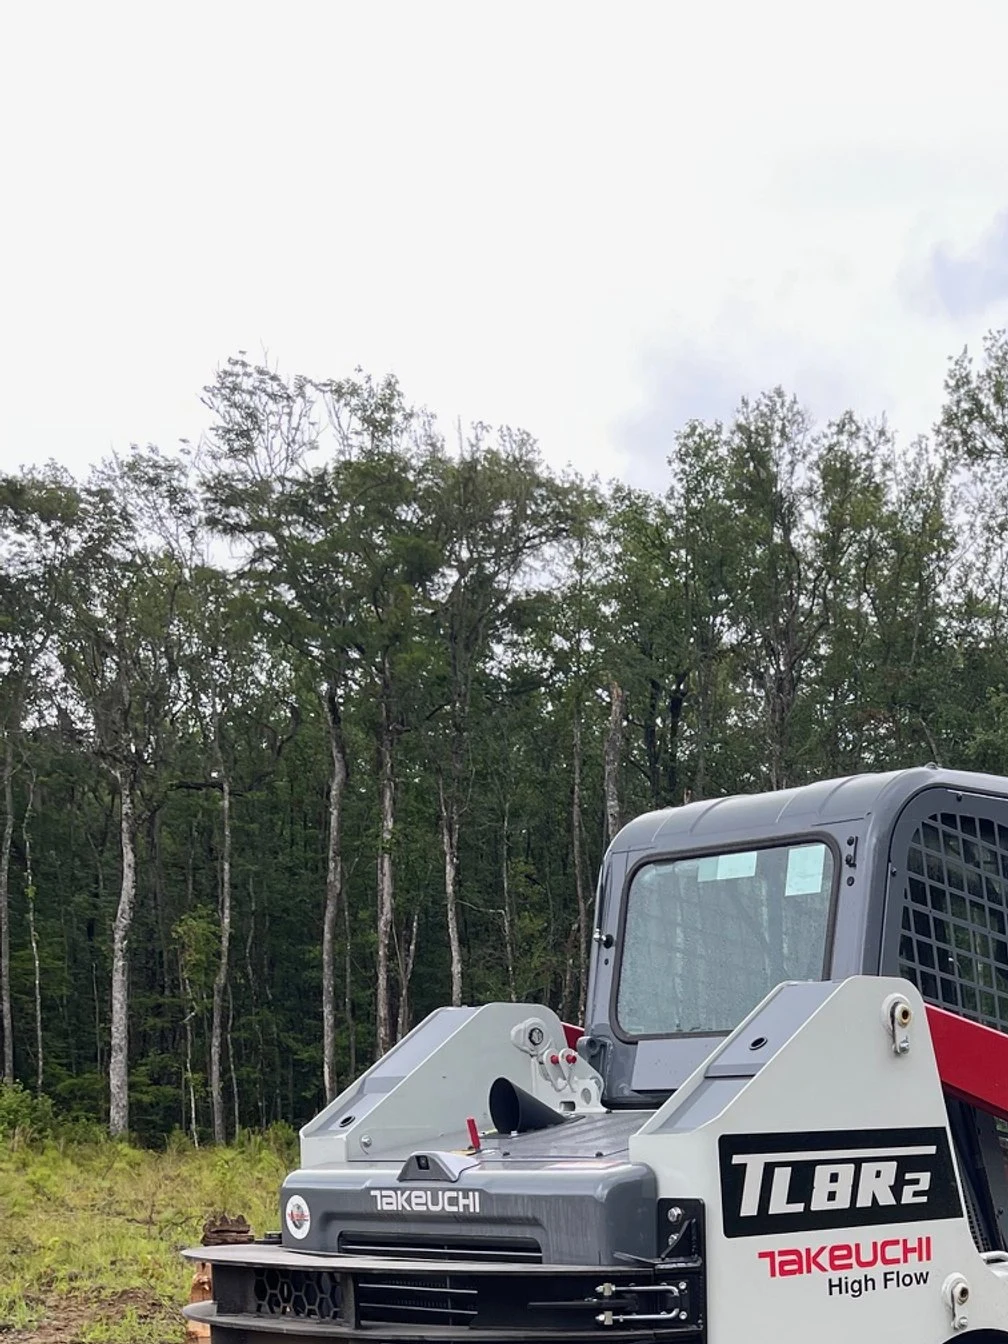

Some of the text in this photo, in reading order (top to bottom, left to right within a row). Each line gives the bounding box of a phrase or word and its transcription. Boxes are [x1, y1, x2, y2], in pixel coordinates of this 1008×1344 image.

[731, 1145, 937, 1218] TL8R2
[828, 1270, 930, 1298] High Flow
